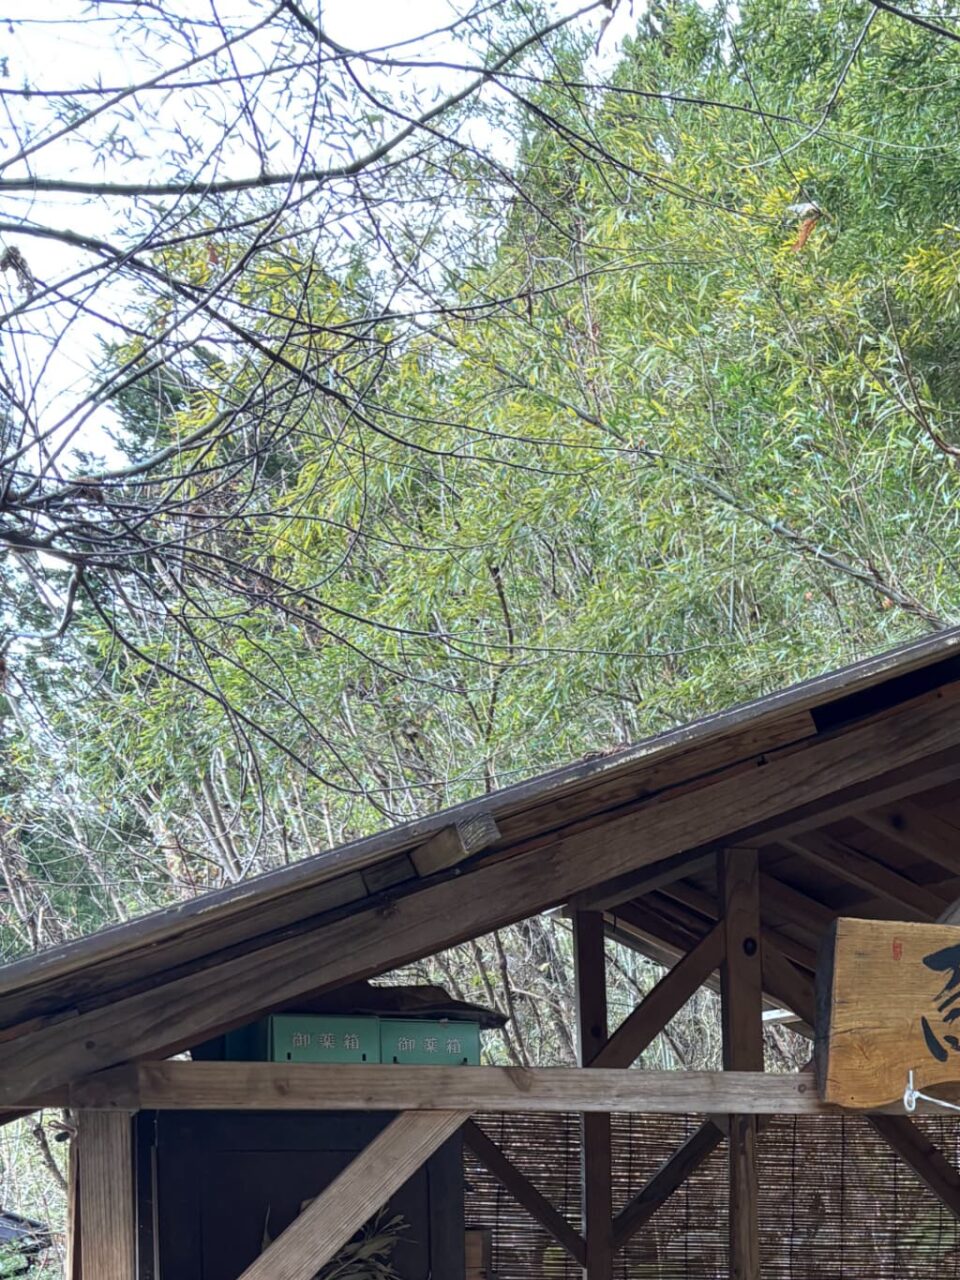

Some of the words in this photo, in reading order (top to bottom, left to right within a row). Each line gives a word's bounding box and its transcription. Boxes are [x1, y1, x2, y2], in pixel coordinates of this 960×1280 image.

[293, 1033, 360, 1049] 御薬箱
[397, 1036, 462, 1054] 御薬箱
